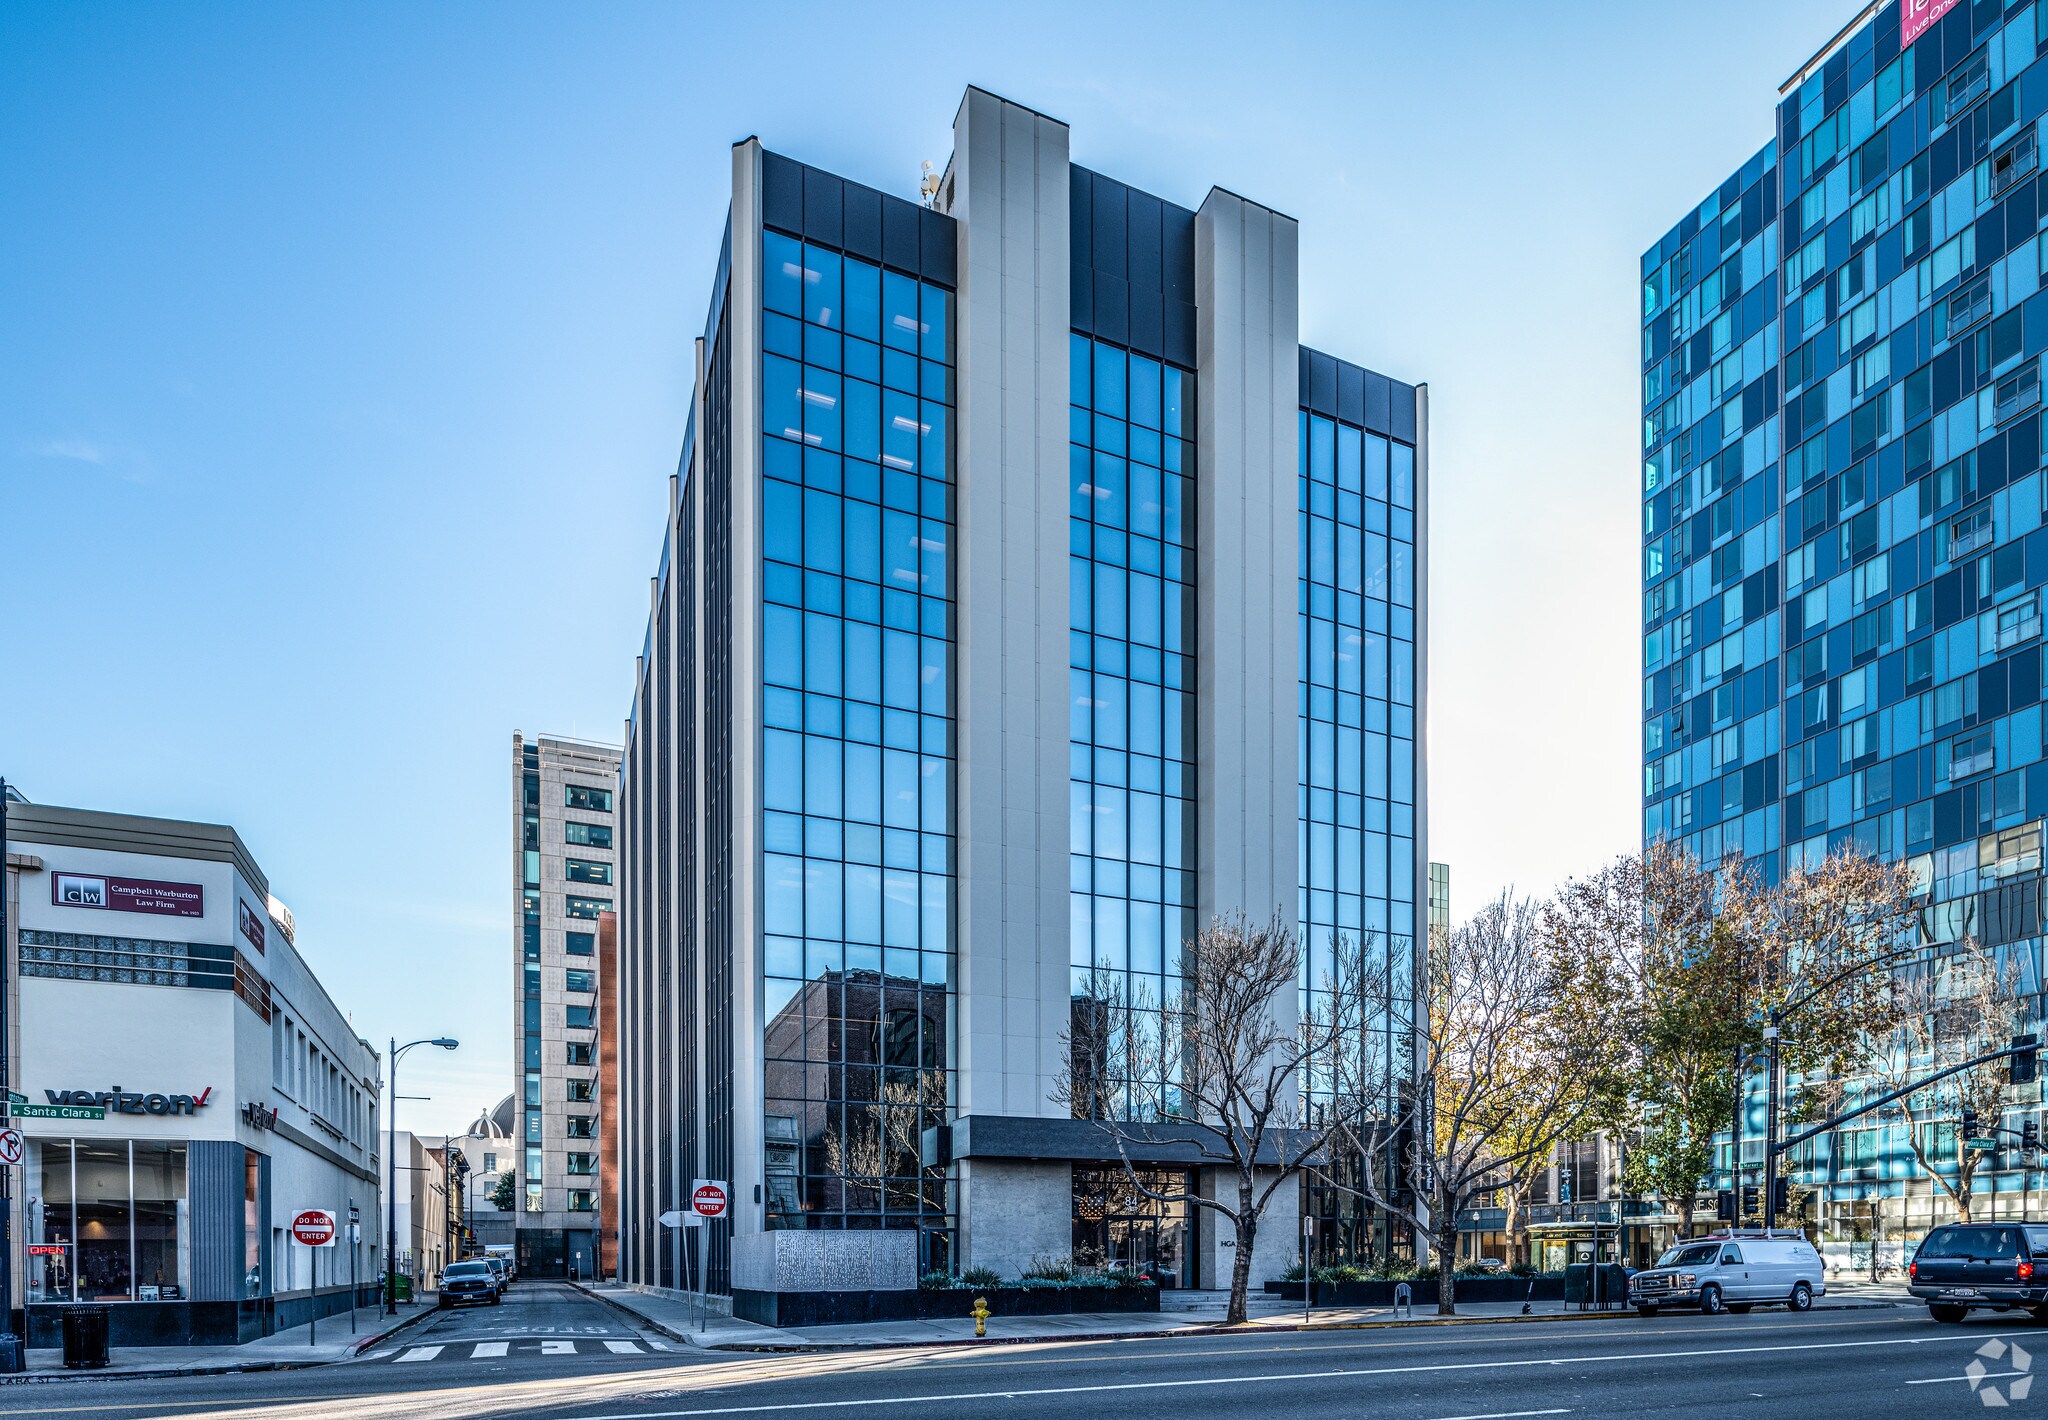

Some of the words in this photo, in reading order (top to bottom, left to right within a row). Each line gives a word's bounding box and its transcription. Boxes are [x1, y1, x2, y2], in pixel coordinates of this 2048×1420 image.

[111, 885, 152, 896] Campbell
[154, 889, 199, 899] Warburton
[136, 899, 154, 907] Law
[156, 900, 175, 908] Firm
[44, 1086, 193, 1115] verizon
[23, 1106, 57, 1117] Santa
[61, 1108, 91, 1118] Clara
[1125, 1196, 1137, 1206] 84
[30, 1246, 65, 1255] OPEN
